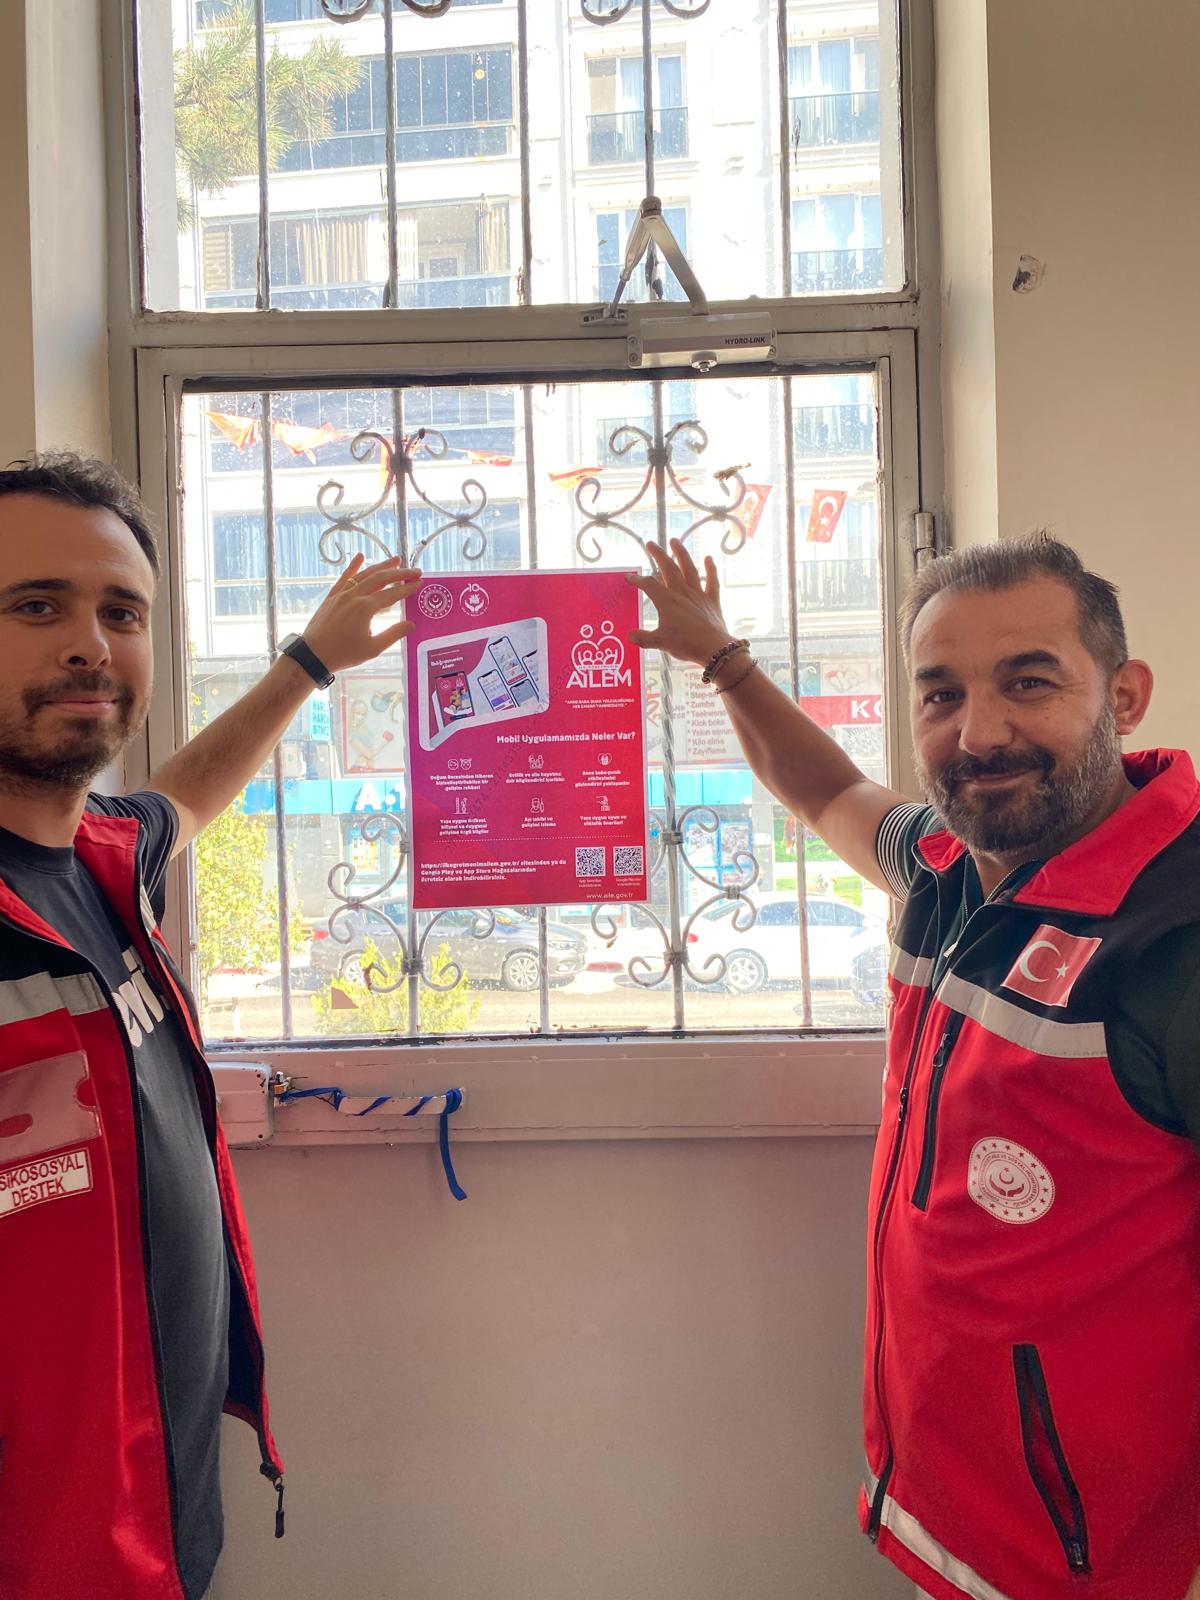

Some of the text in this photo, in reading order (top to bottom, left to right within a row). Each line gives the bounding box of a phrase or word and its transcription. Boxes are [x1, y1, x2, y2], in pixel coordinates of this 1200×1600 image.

[725, 336, 766, 345] HYDRO-LINK
[522, 734, 590, 744] Uygulamamızda
[592, 732, 614, 741] Neler
[616, 731, 636, 740] Var?
[586, 892, 634, 900] www.aile.gov.tr
[0, 1154, 84, 1192] SİKOSOSYAL
[12, 1176, 66, 1207] DESTEK
